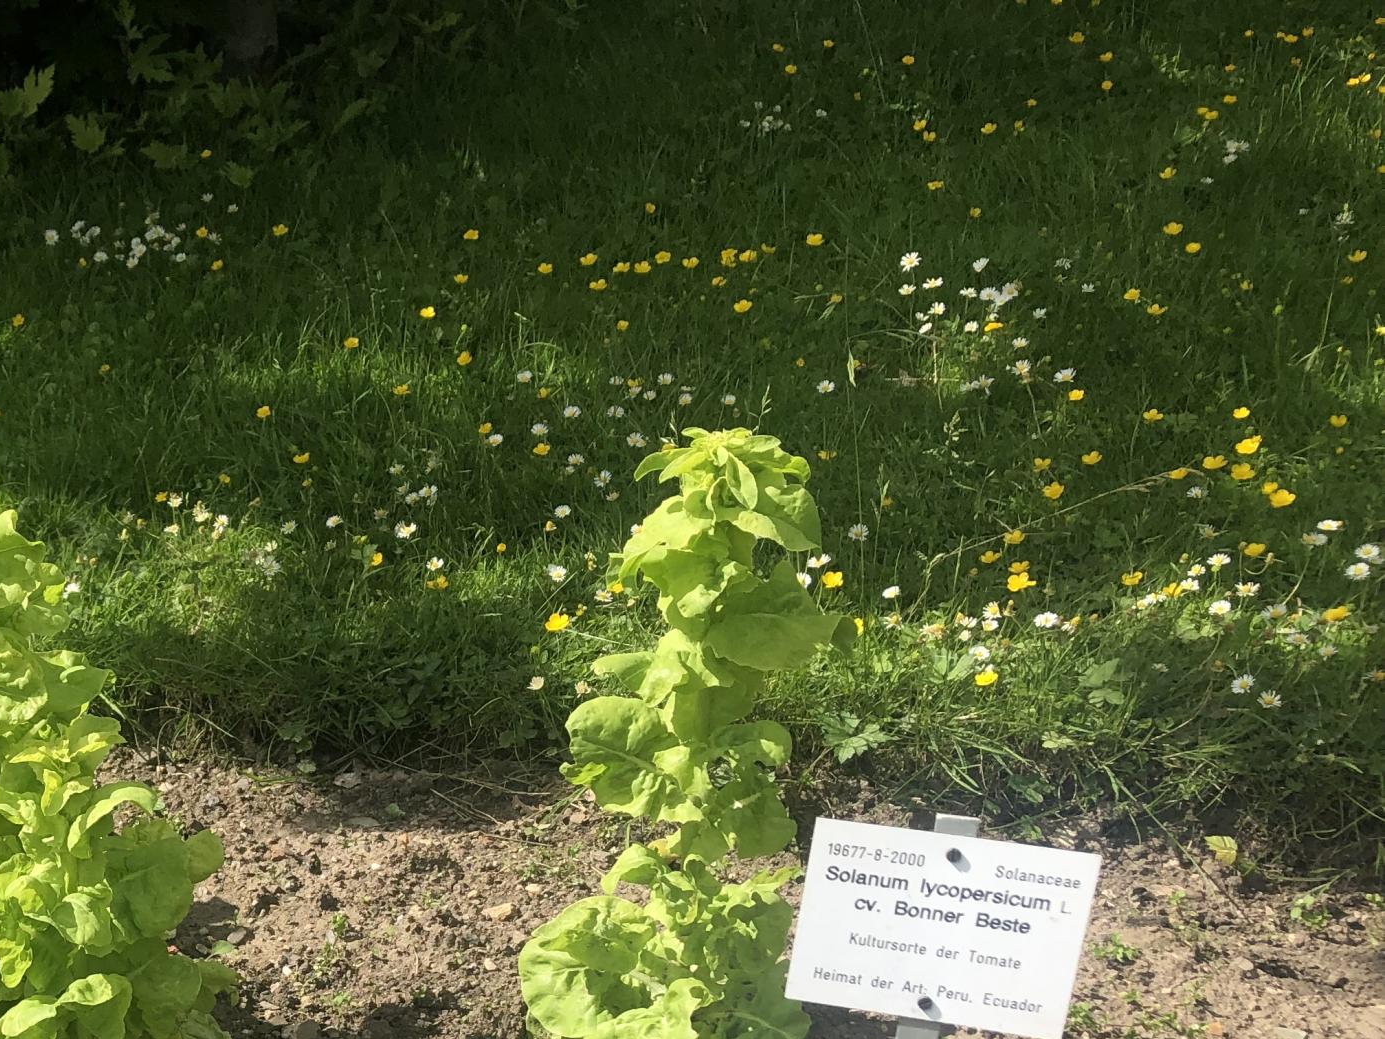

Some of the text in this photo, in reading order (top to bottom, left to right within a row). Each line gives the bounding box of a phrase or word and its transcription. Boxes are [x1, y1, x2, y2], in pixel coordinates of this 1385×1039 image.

[825, 865, 909, 891] Solanum
[920, 878, 1051, 911] lycopersicum
[827, 843, 1081, 889] 19677-8-2000 Solanaceae
[854, 898, 1031, 934] cv. Bonner Beste
[849, 932, 1022, 969] Kultursorte der Tomate
[813, 967, 862, 985] Heimat
[871, 975, 894, 990] der
[902, 980, 928, 995] Art:
[982, 993, 1043, 1014] Ecuador
